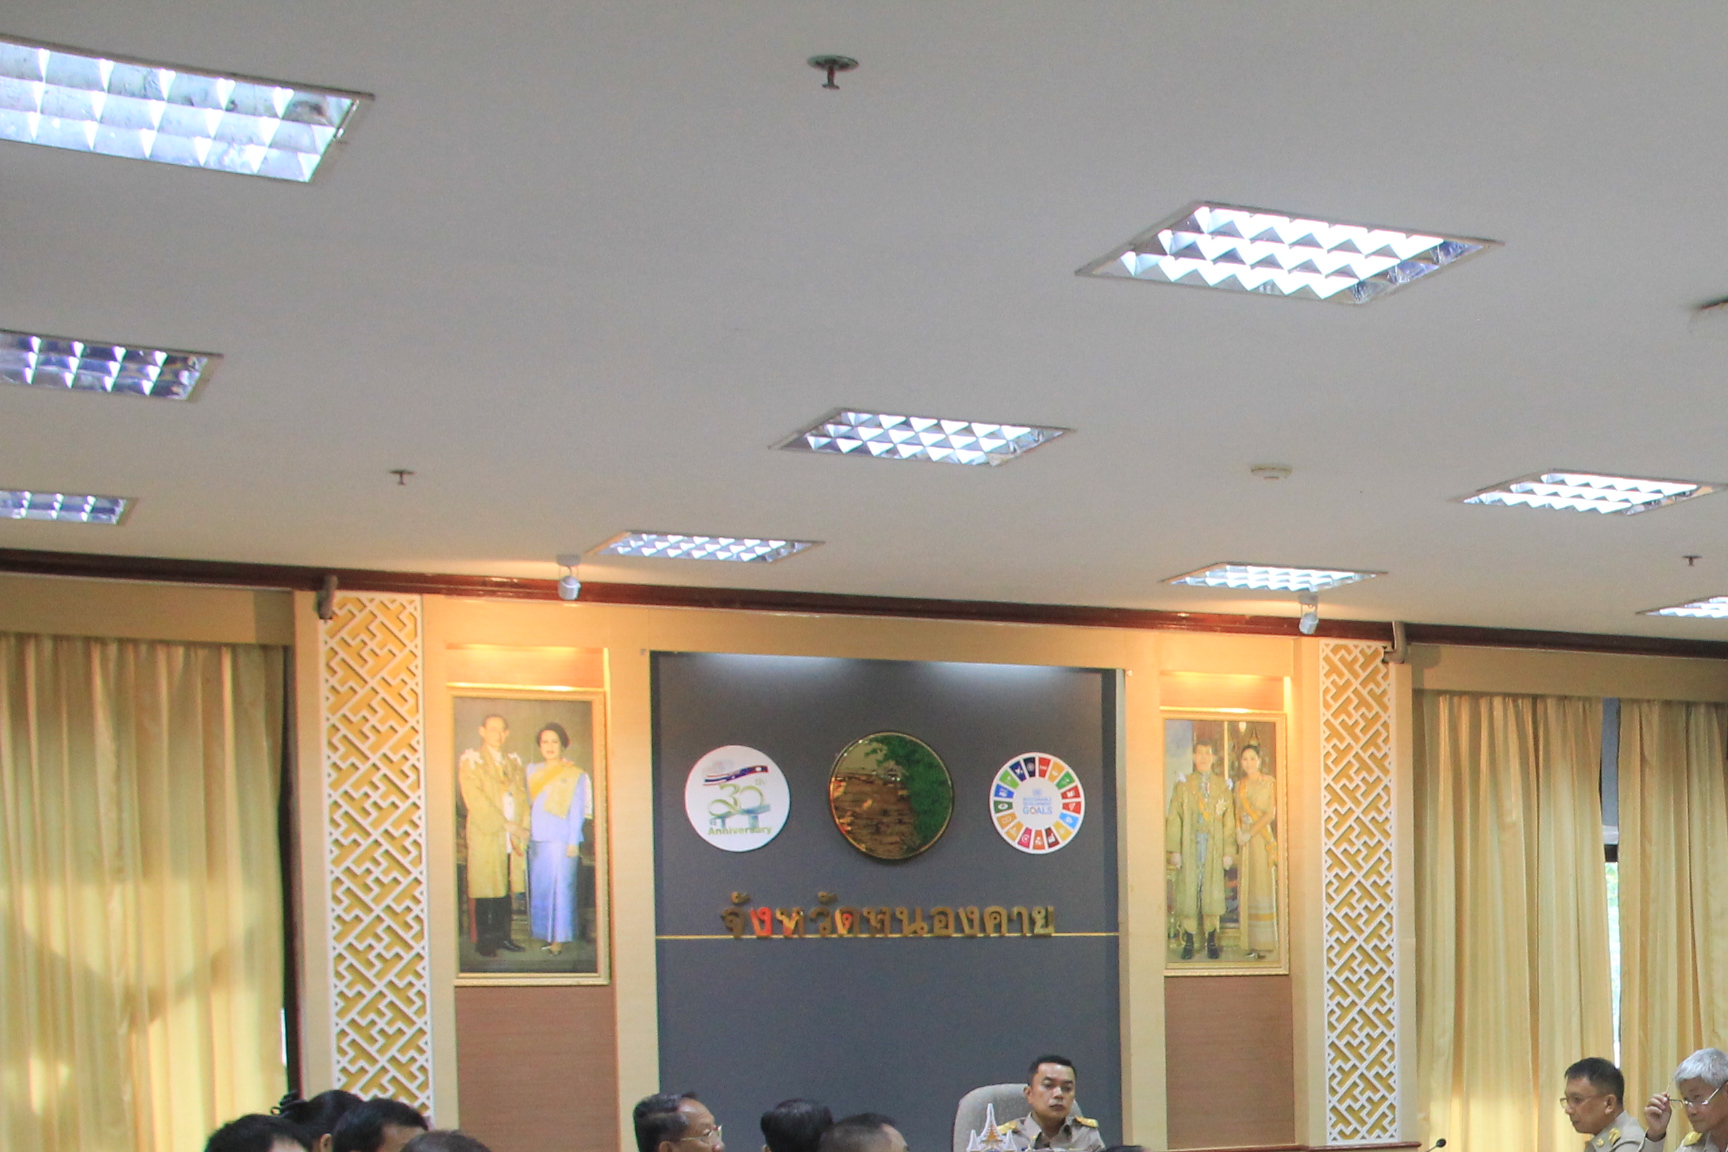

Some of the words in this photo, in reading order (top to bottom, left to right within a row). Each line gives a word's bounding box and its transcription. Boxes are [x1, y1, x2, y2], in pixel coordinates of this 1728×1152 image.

[1023, 806, 1053, 815] GOALS
[708, 827, 772, 836] Anniversary
[721, 891, 1056, 938] จังหวัดหนองคาย
